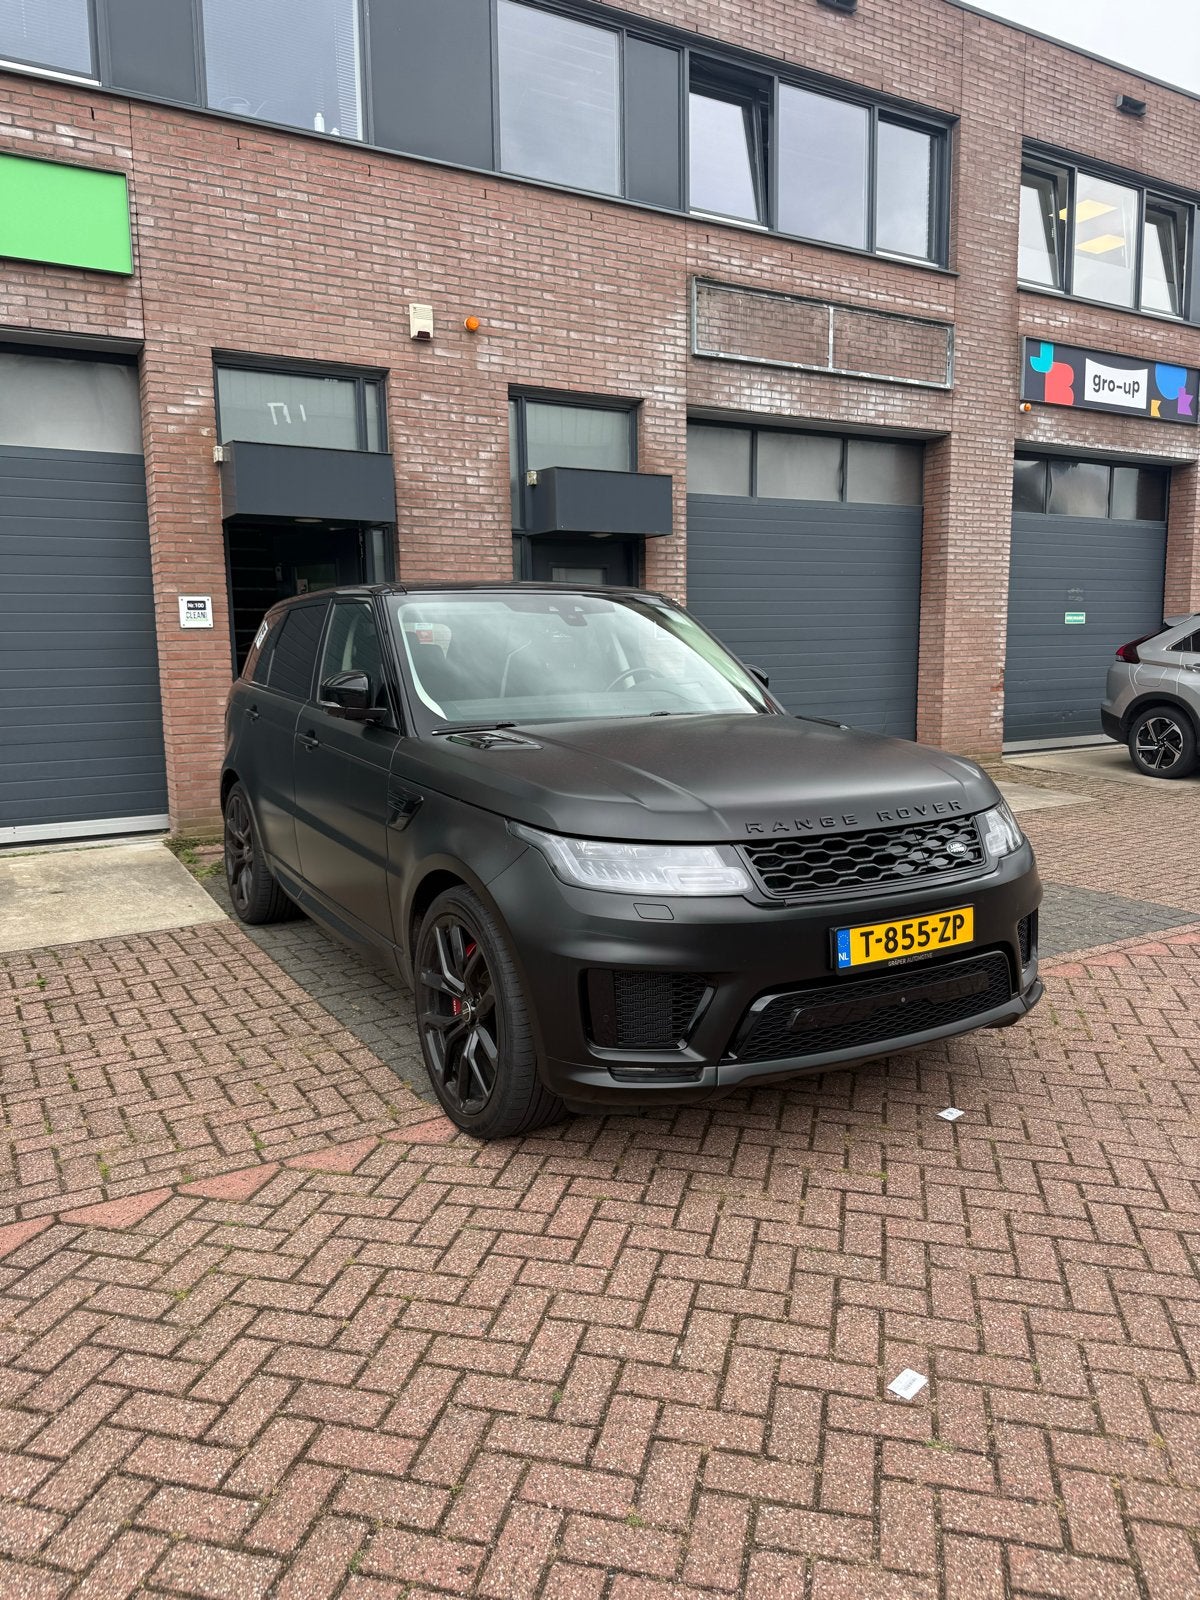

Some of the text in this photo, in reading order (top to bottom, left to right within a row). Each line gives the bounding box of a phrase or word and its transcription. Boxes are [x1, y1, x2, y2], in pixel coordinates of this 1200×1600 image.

[1092, 373, 1140, 398] gro-up
[744, 800, 963, 834] RANGE ROVER
[859, 913, 965, 958] T-855-ZP
[838, 952, 849, 962] NL
